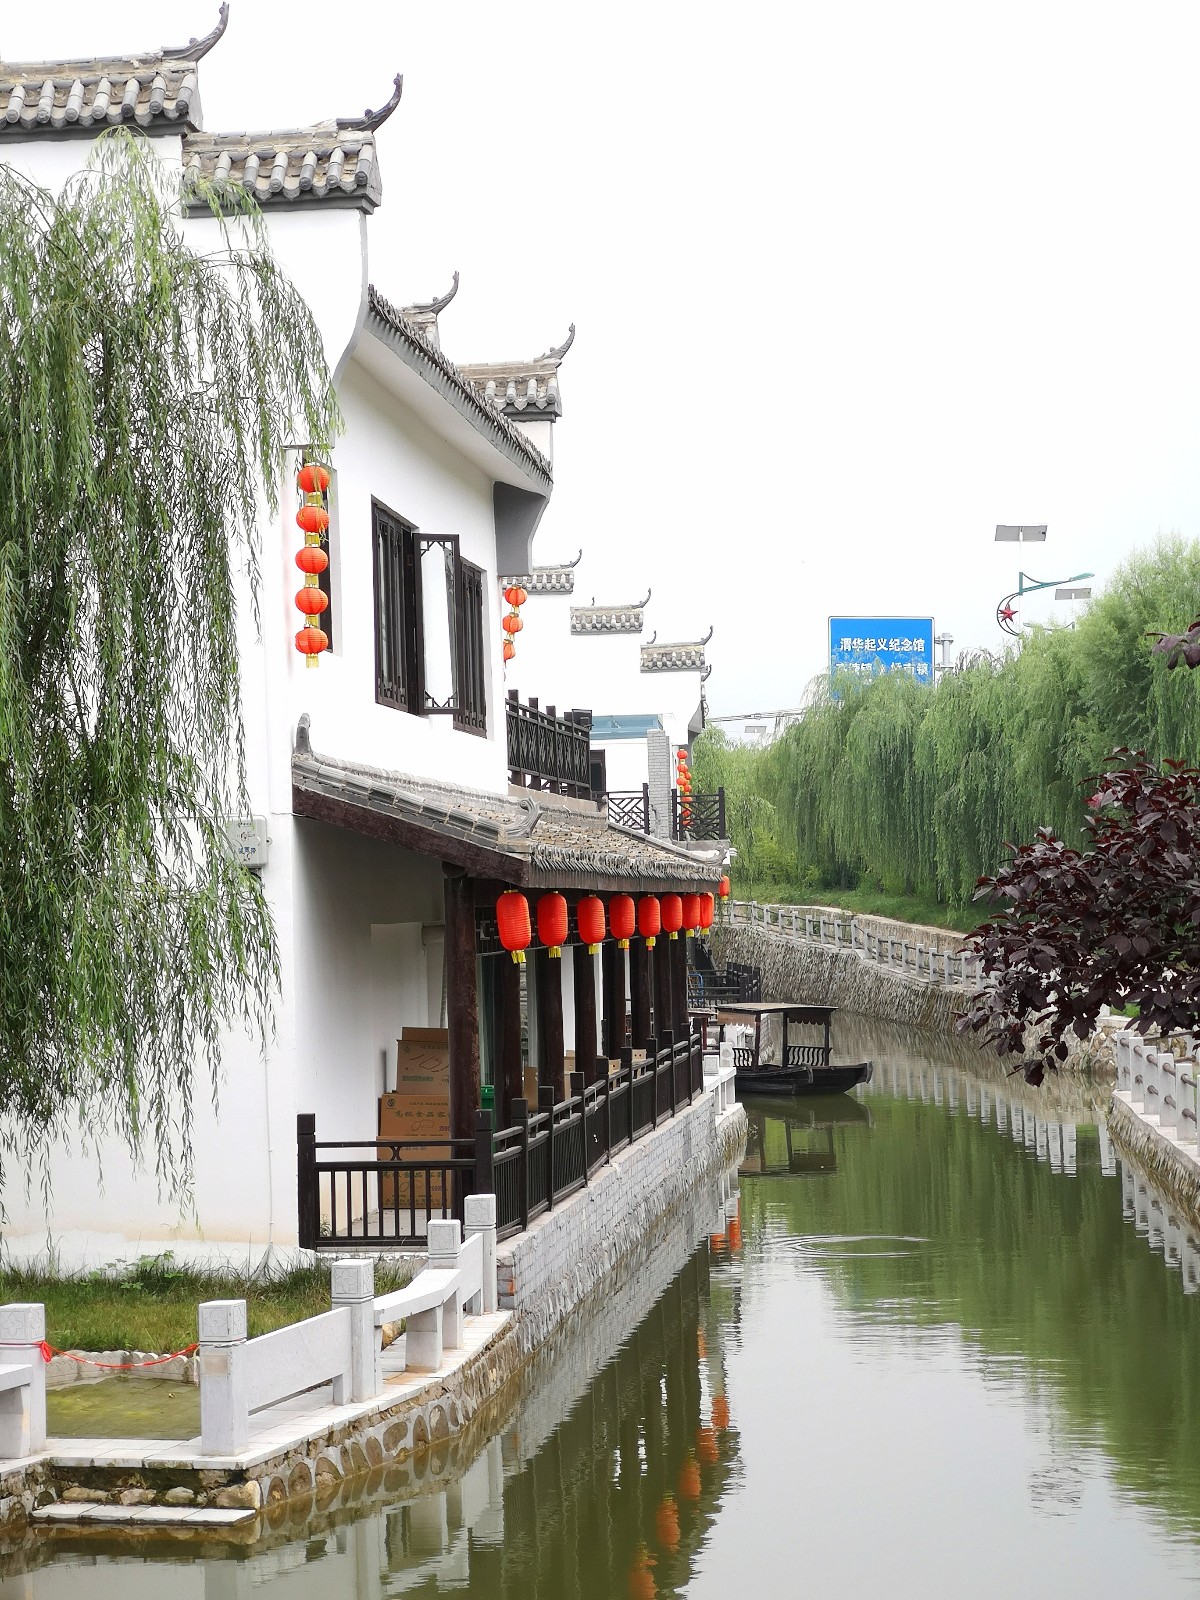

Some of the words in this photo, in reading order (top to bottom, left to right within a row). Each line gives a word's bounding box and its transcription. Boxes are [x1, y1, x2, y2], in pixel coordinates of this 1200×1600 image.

[840, 638, 925, 651] 渭华起义纪念馆
